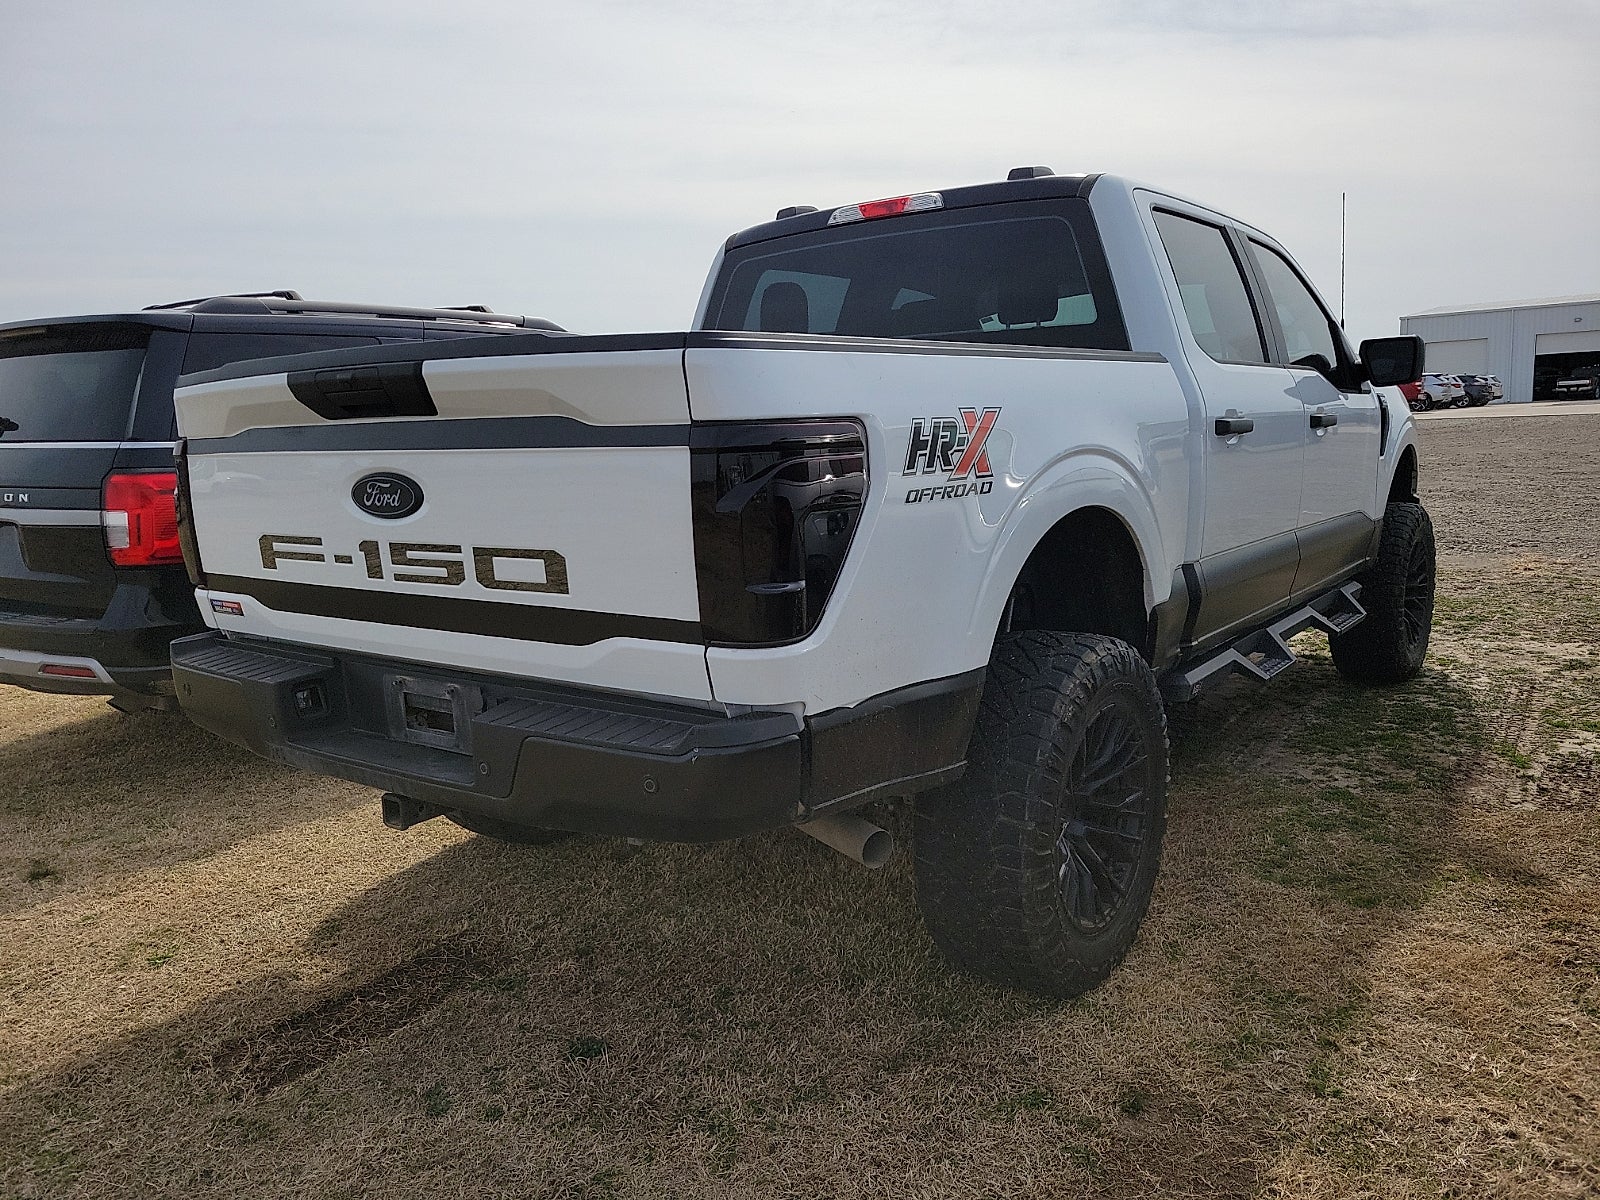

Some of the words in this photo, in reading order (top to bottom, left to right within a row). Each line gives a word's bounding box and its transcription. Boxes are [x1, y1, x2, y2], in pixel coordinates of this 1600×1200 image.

[363, 481, 401, 507] Ford
[904, 481, 993, 504] OFFROAD
[258, 533, 570, 595] F-150
